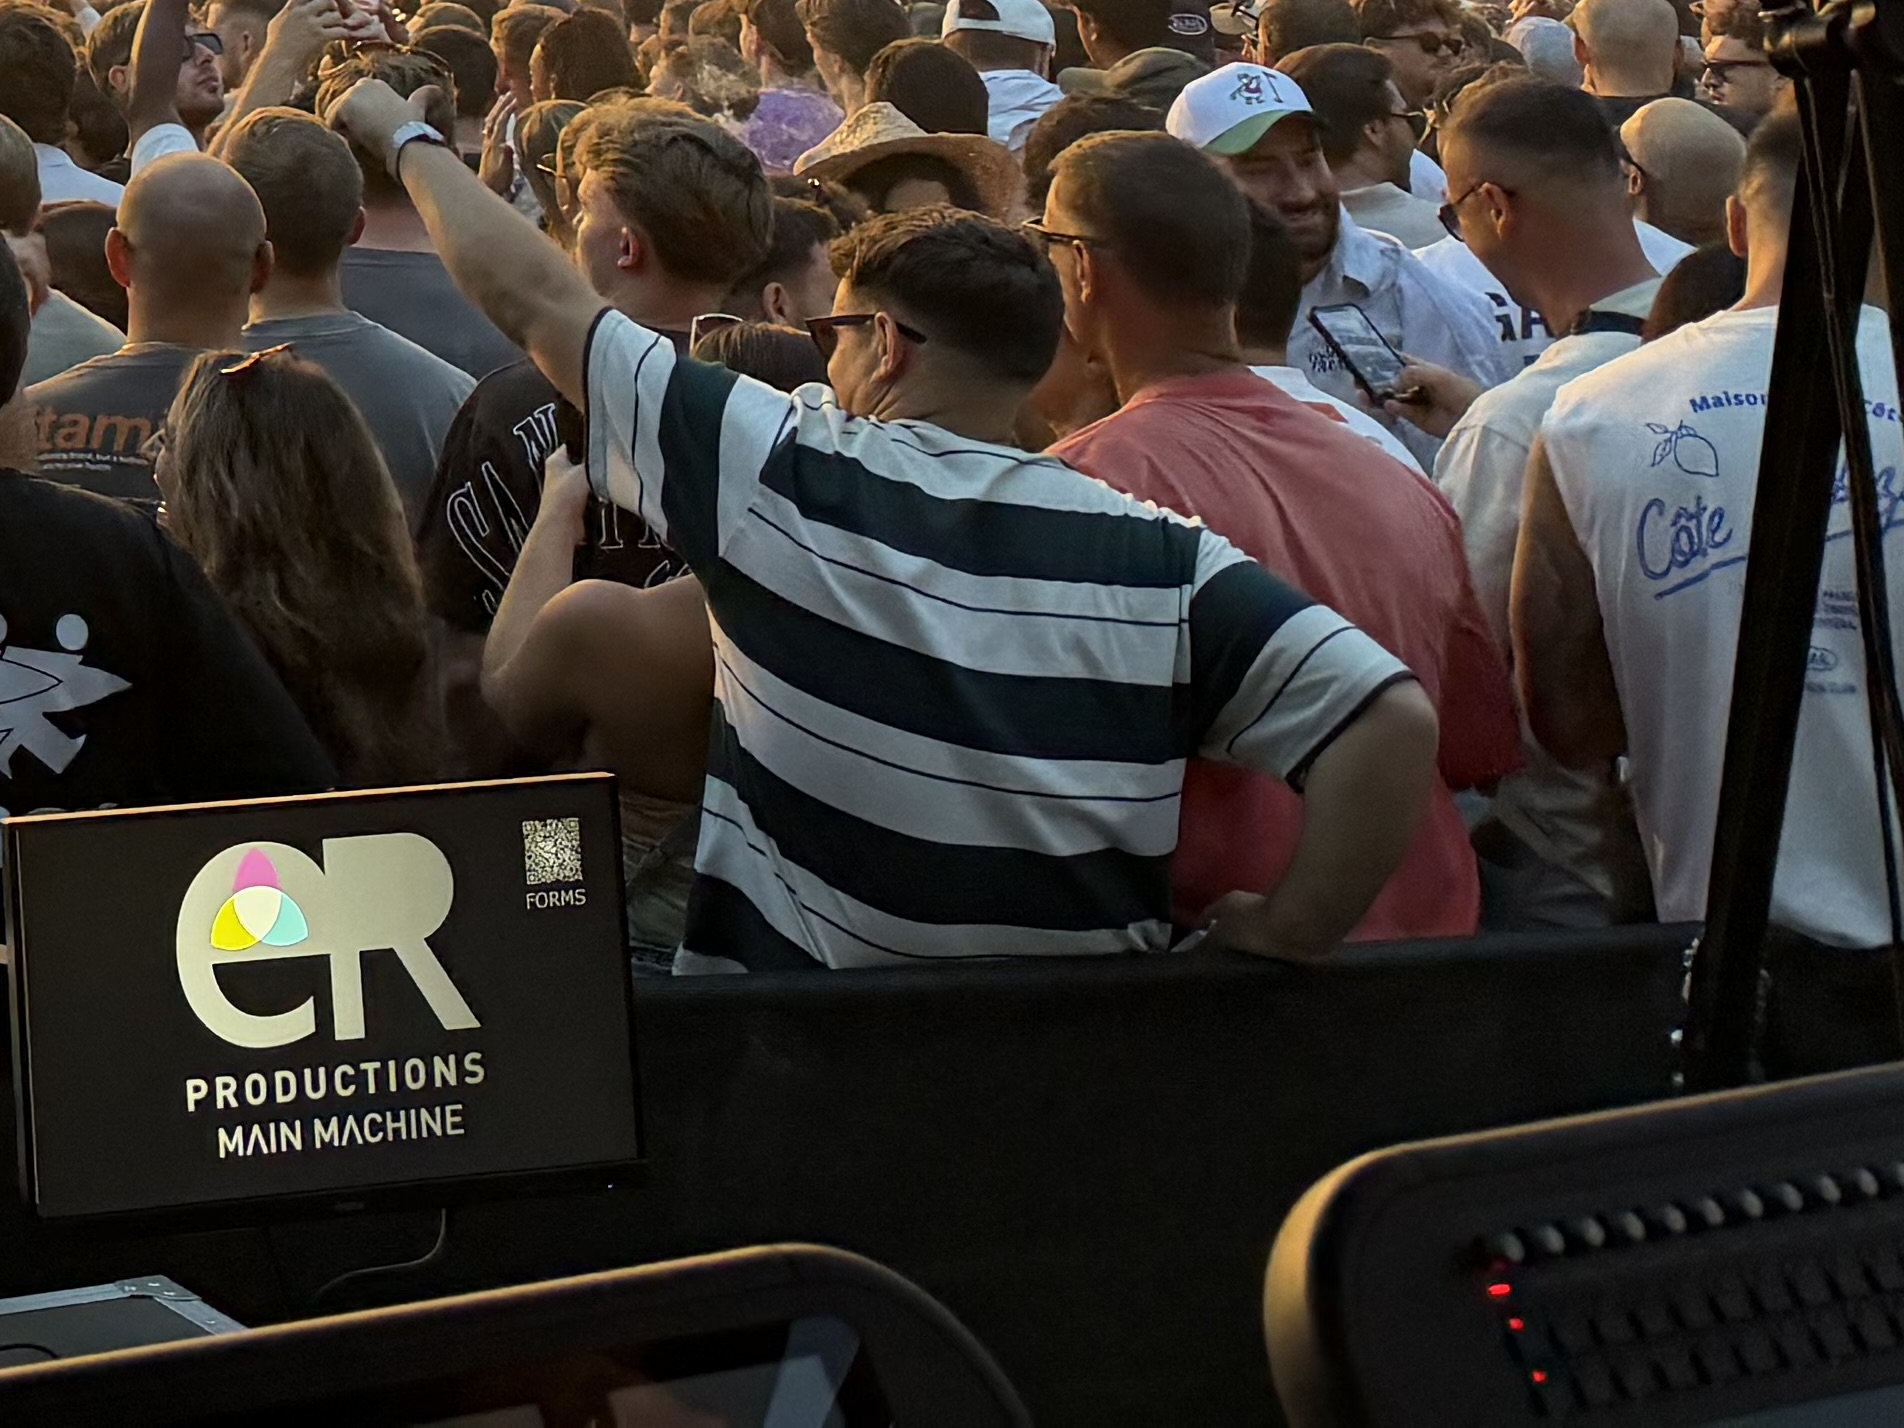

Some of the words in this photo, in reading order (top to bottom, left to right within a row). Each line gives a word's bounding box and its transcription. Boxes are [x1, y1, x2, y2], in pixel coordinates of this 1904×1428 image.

[1637, 495, 1733, 580] Côte
[525, 889, 587, 910] FORMS
[186, 1052, 486, 1112] PRODUCTIONS
[217, 1120, 302, 1159] MAIN
[314, 1104, 466, 1149] MACHINE
